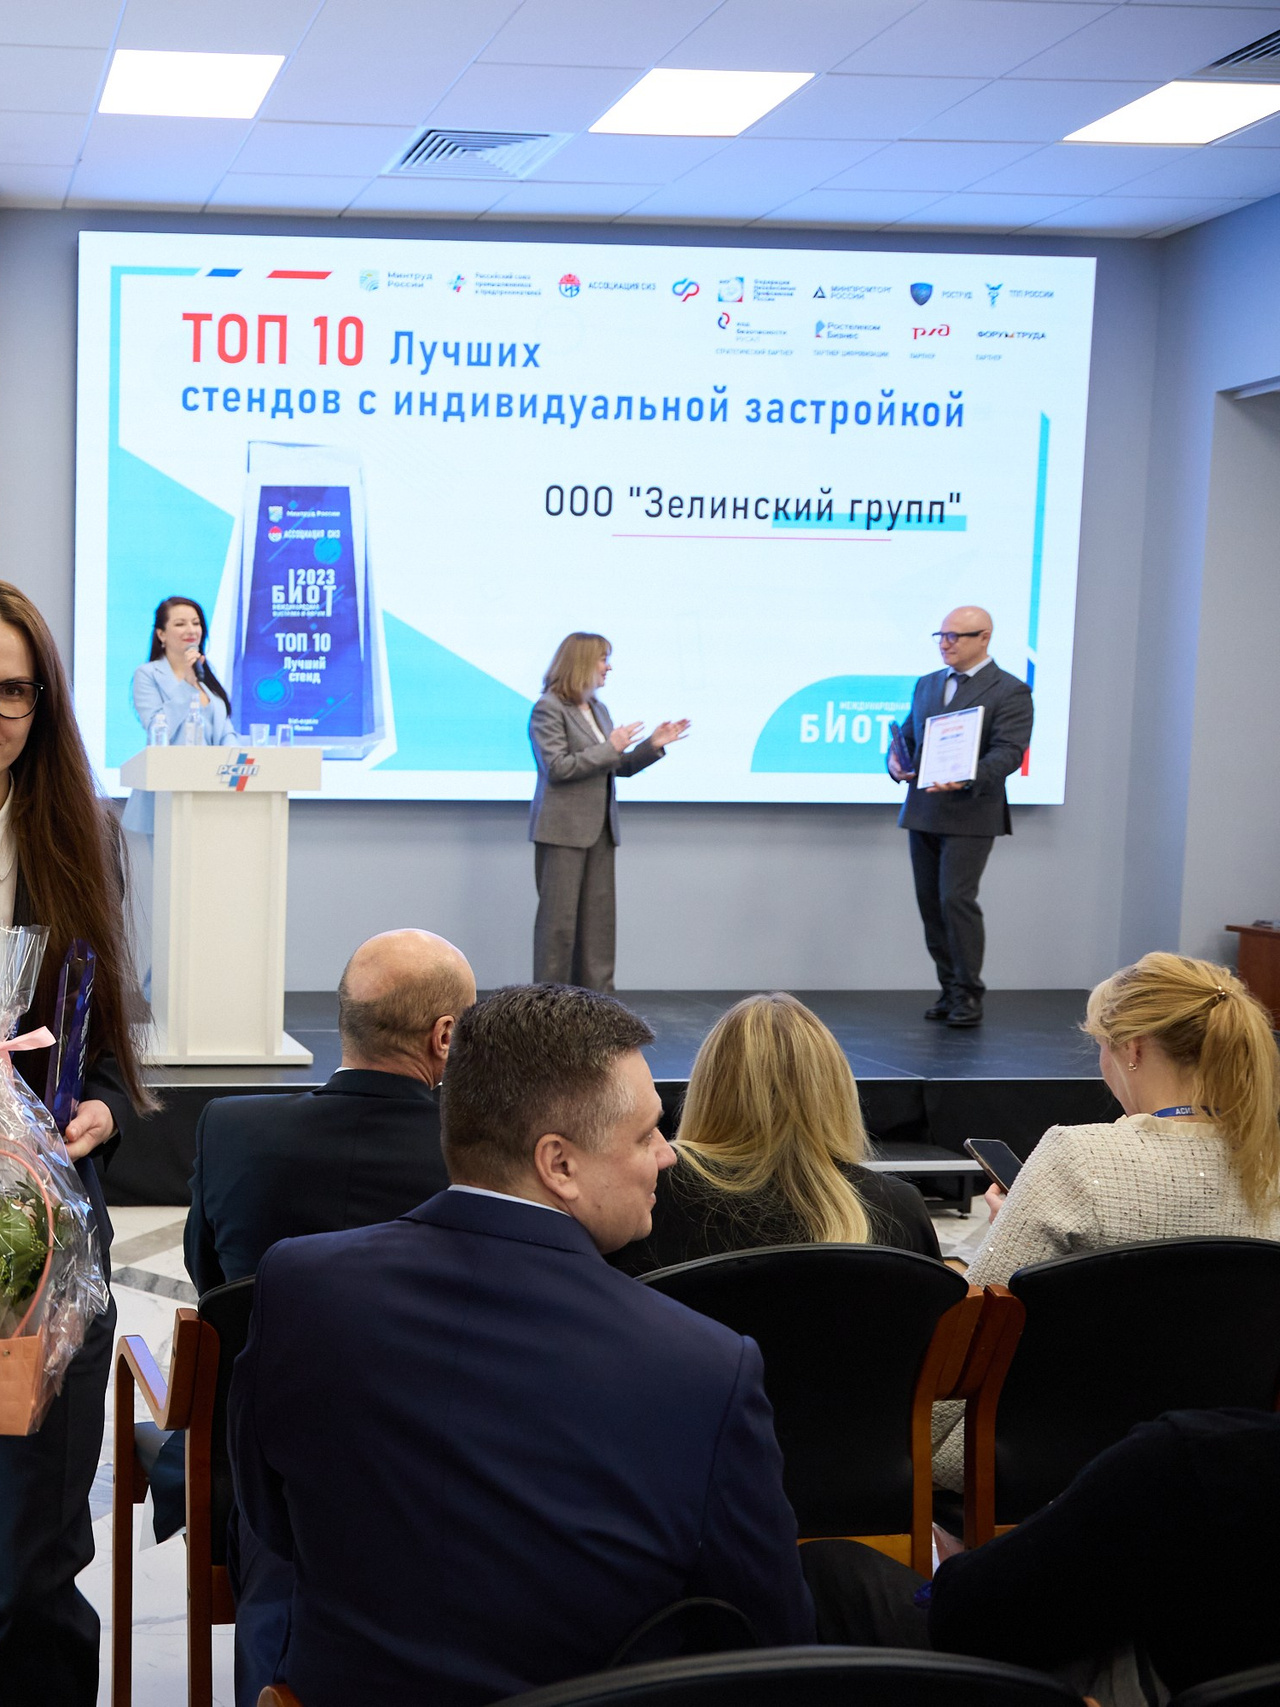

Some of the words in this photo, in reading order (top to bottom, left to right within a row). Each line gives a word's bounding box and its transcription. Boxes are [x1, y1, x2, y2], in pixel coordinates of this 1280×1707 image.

[588, 281, 639, 290] АССОЦИАЦИЯ
[182, 312, 289, 365] ТОП
[314, 315, 365, 367] 10
[390, 331, 541, 376] Лучших
[182, 386, 341, 420] стендов
[358, 390, 377, 416] с
[394, 385, 729, 430] индивидуальной
[745, 388, 965, 435] застройкой
[545, 484, 613, 518] ООО
[629, 486, 834, 523] "Зелинский
[849, 492, 962, 532] групп"
[296, 568, 336, 586] 2023
[272, 569, 337, 617] БИОТ
[275, 632, 308, 652] ТОП
[312, 632, 332, 652] 10
[284, 656, 327, 672] Лучший
[288, 672, 322, 684] стенд
[800, 701, 896, 754] БИОТ
[218, 764, 259, 776] РСПП
